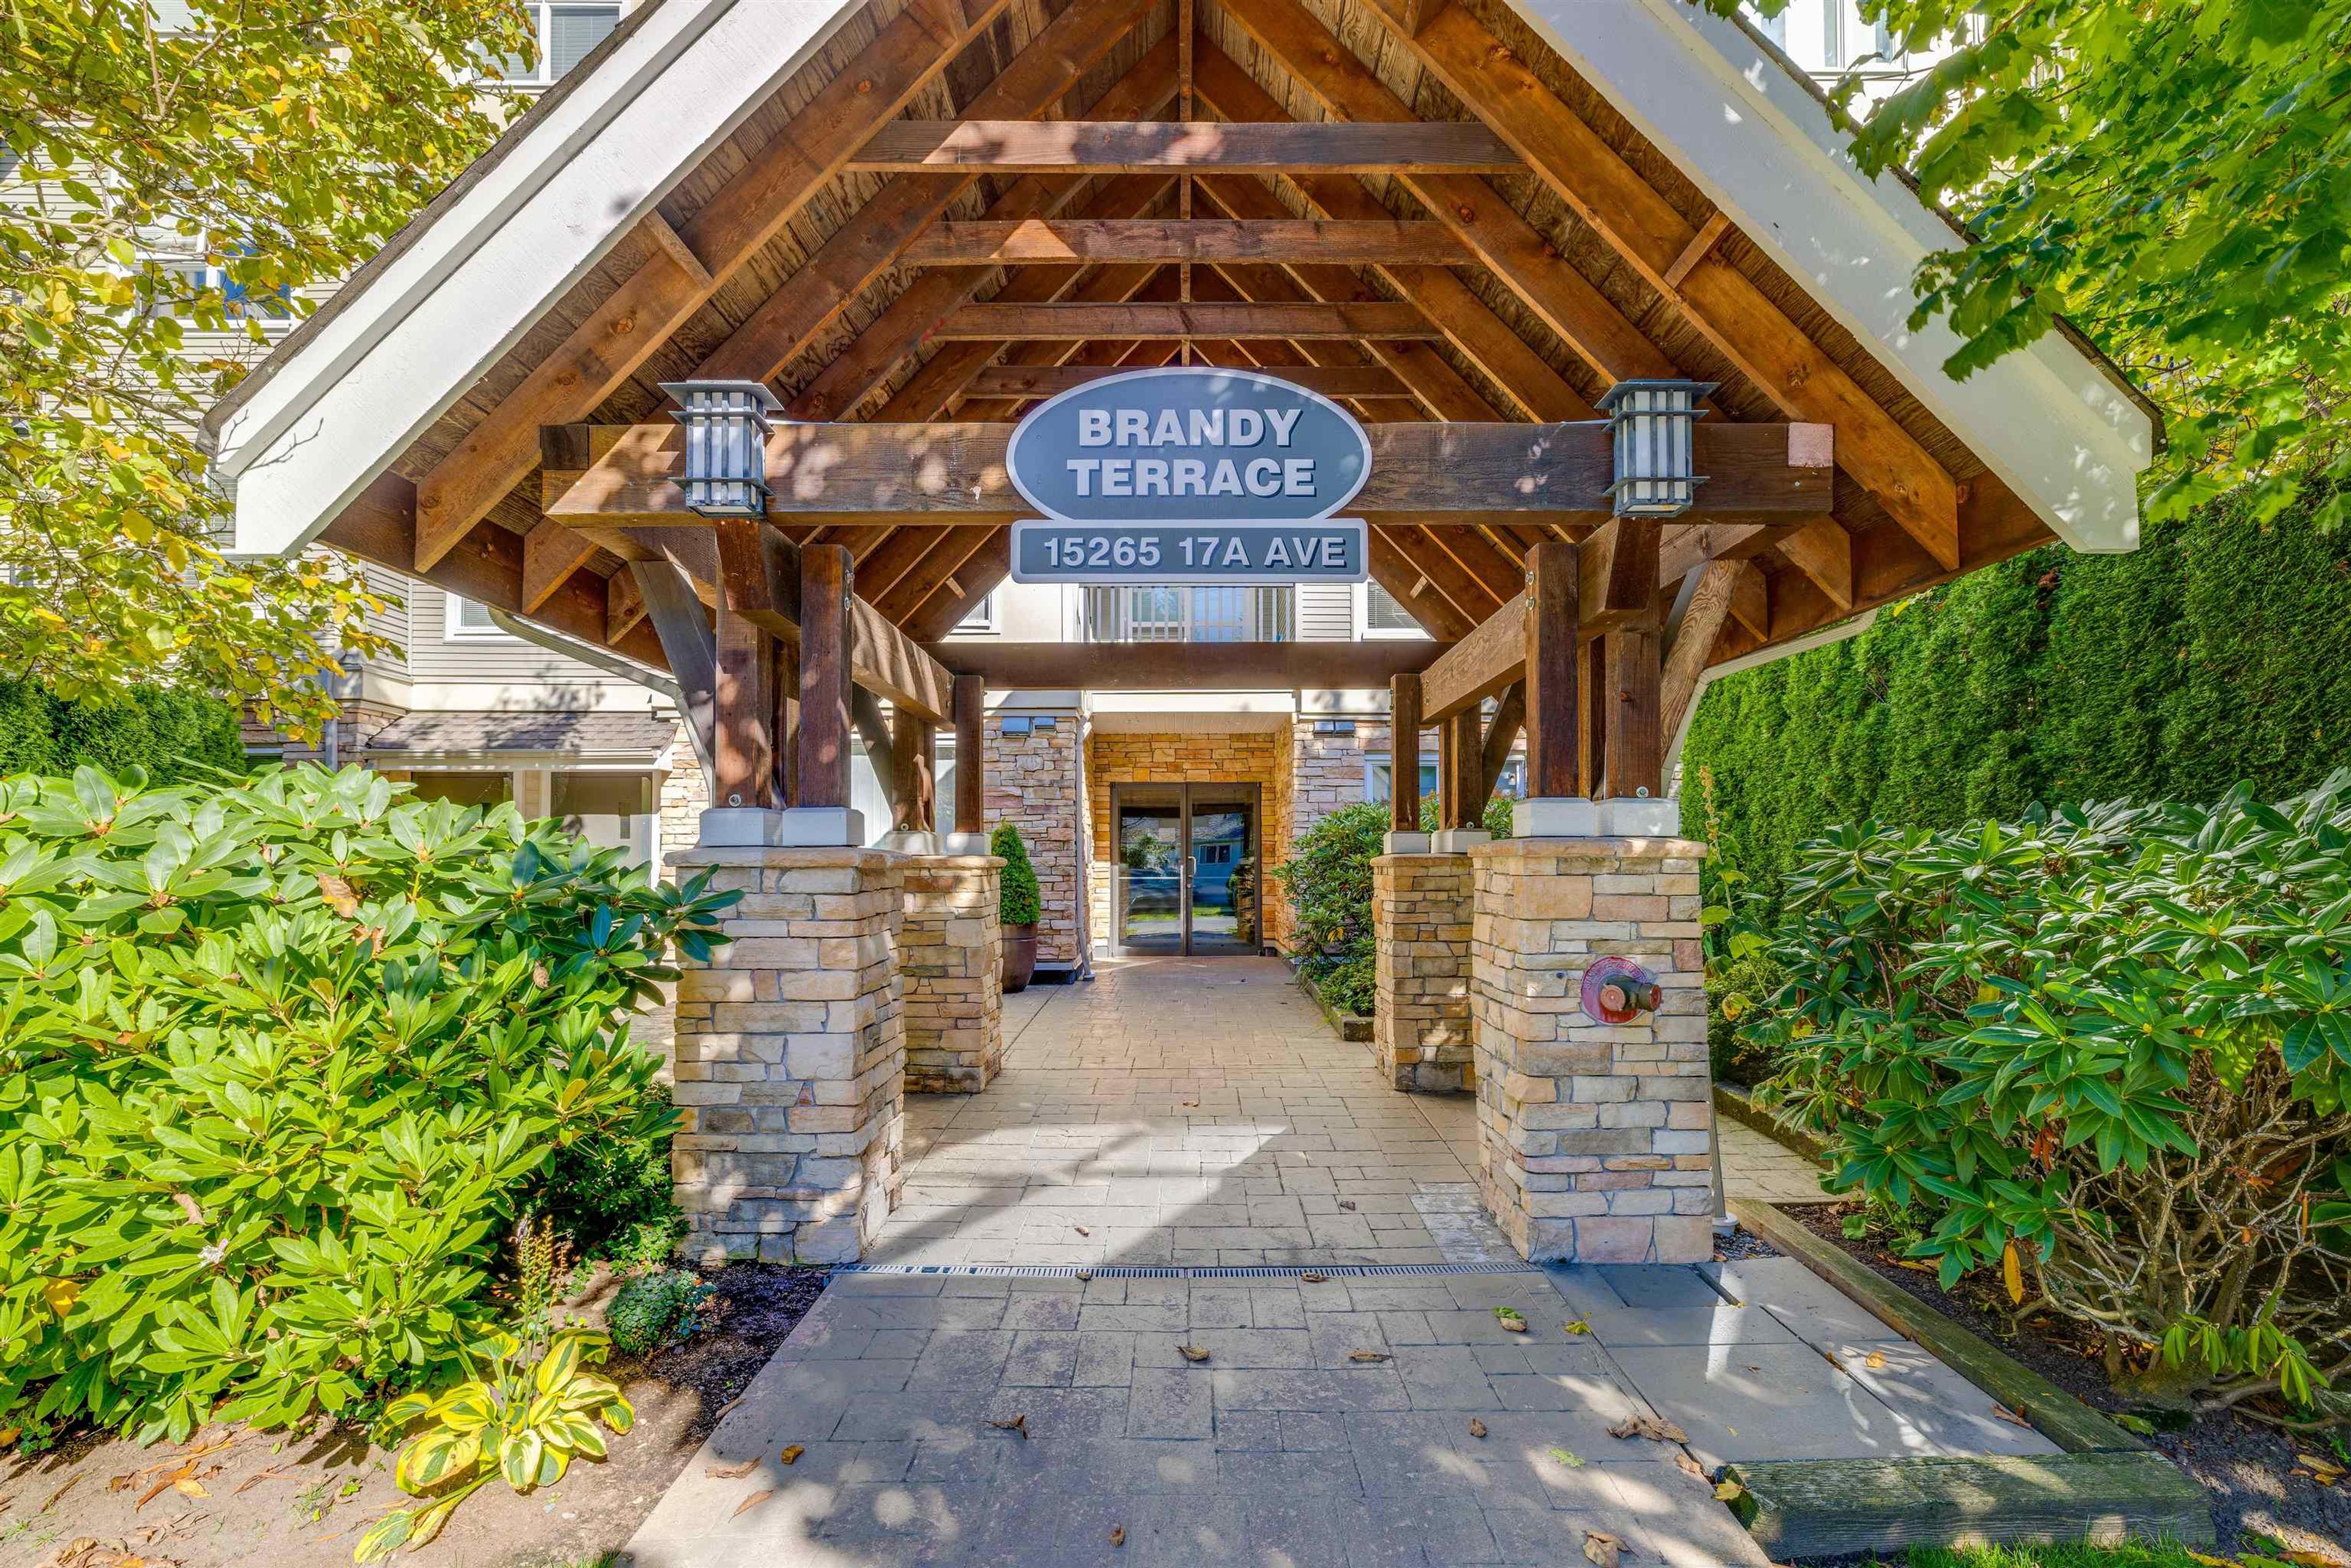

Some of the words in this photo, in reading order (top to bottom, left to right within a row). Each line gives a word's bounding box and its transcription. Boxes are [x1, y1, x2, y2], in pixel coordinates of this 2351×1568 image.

[1078, 408, 1302, 448] BRANDY
[1066, 458, 1316, 497] TERRACE
[1043, 536, 1161, 567] 15265
[1178, 536, 1250, 567] 17A
[1263, 536, 1348, 568] AVE
